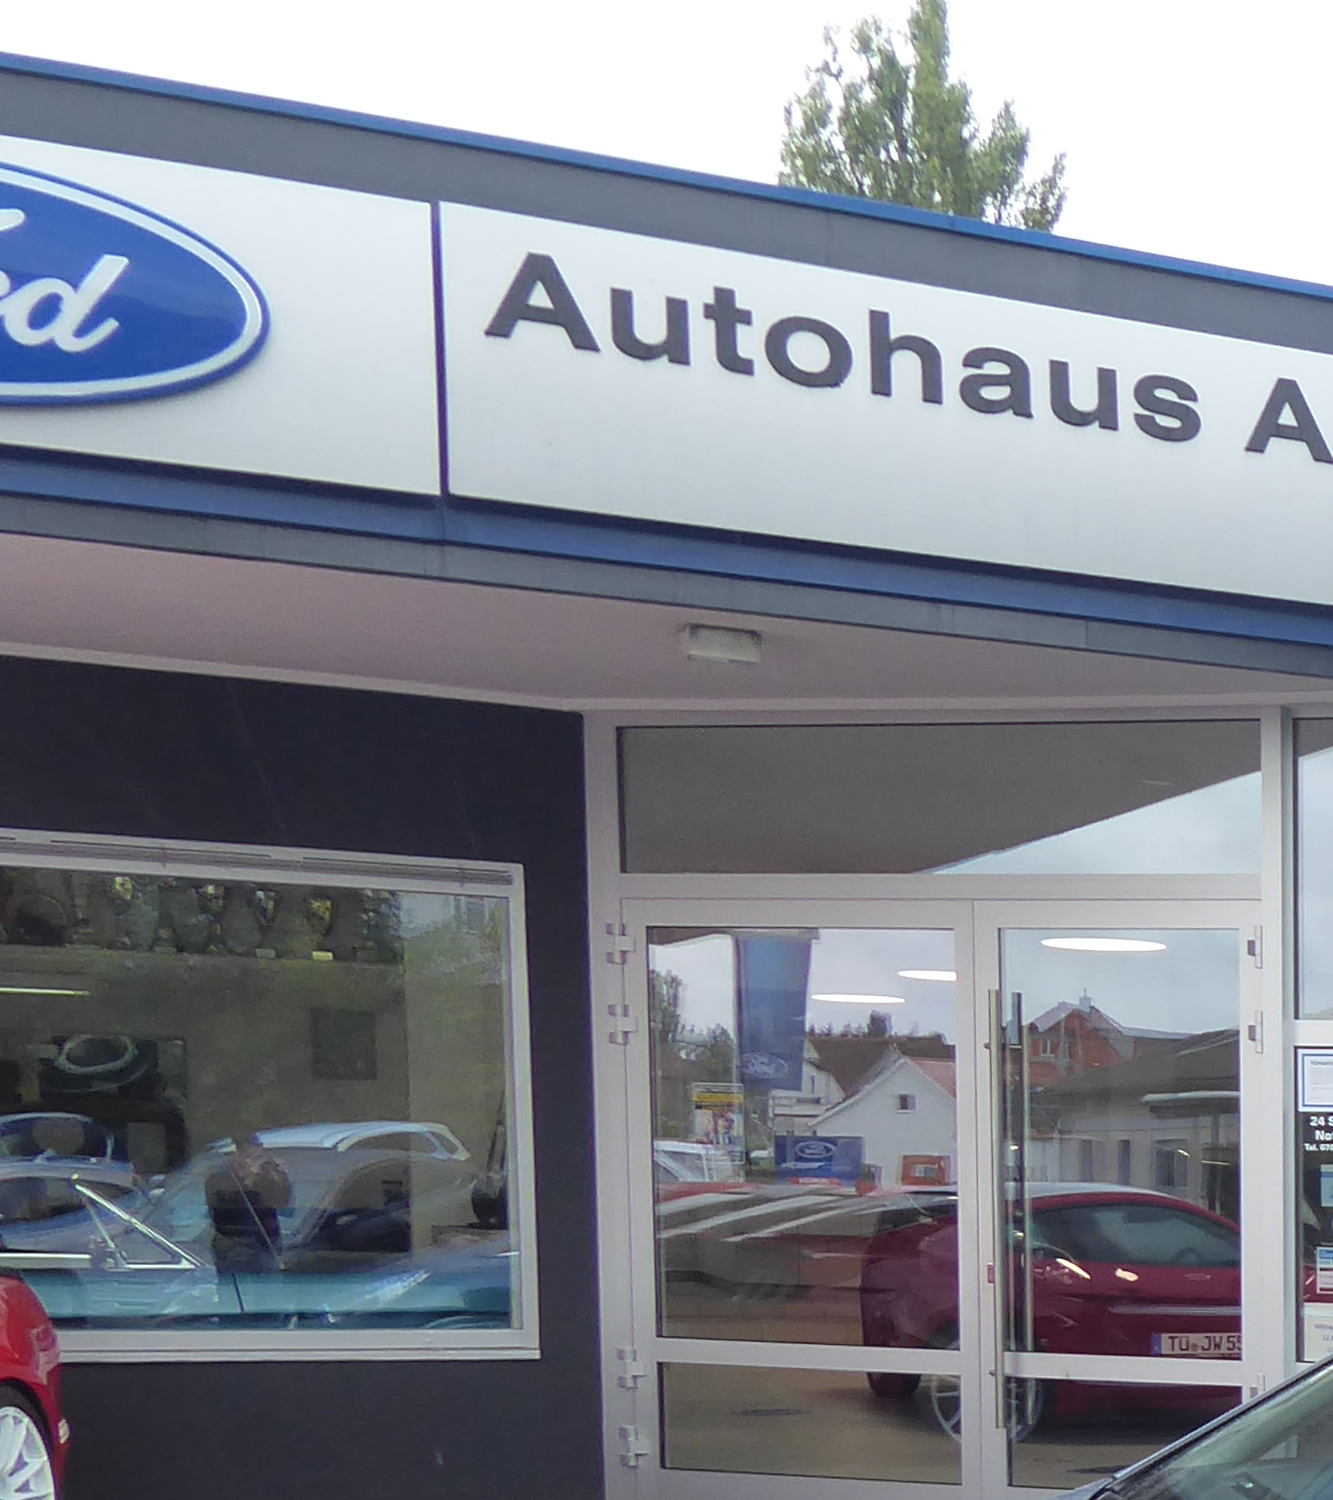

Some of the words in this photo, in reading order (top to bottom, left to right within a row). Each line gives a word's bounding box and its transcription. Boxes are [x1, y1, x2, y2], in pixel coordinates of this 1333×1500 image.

[484, 252, 1203, 442] Autohaus
[1309, 1115, 1326, 1127] 24
[1200, 1335, 1223, 1351] JW
